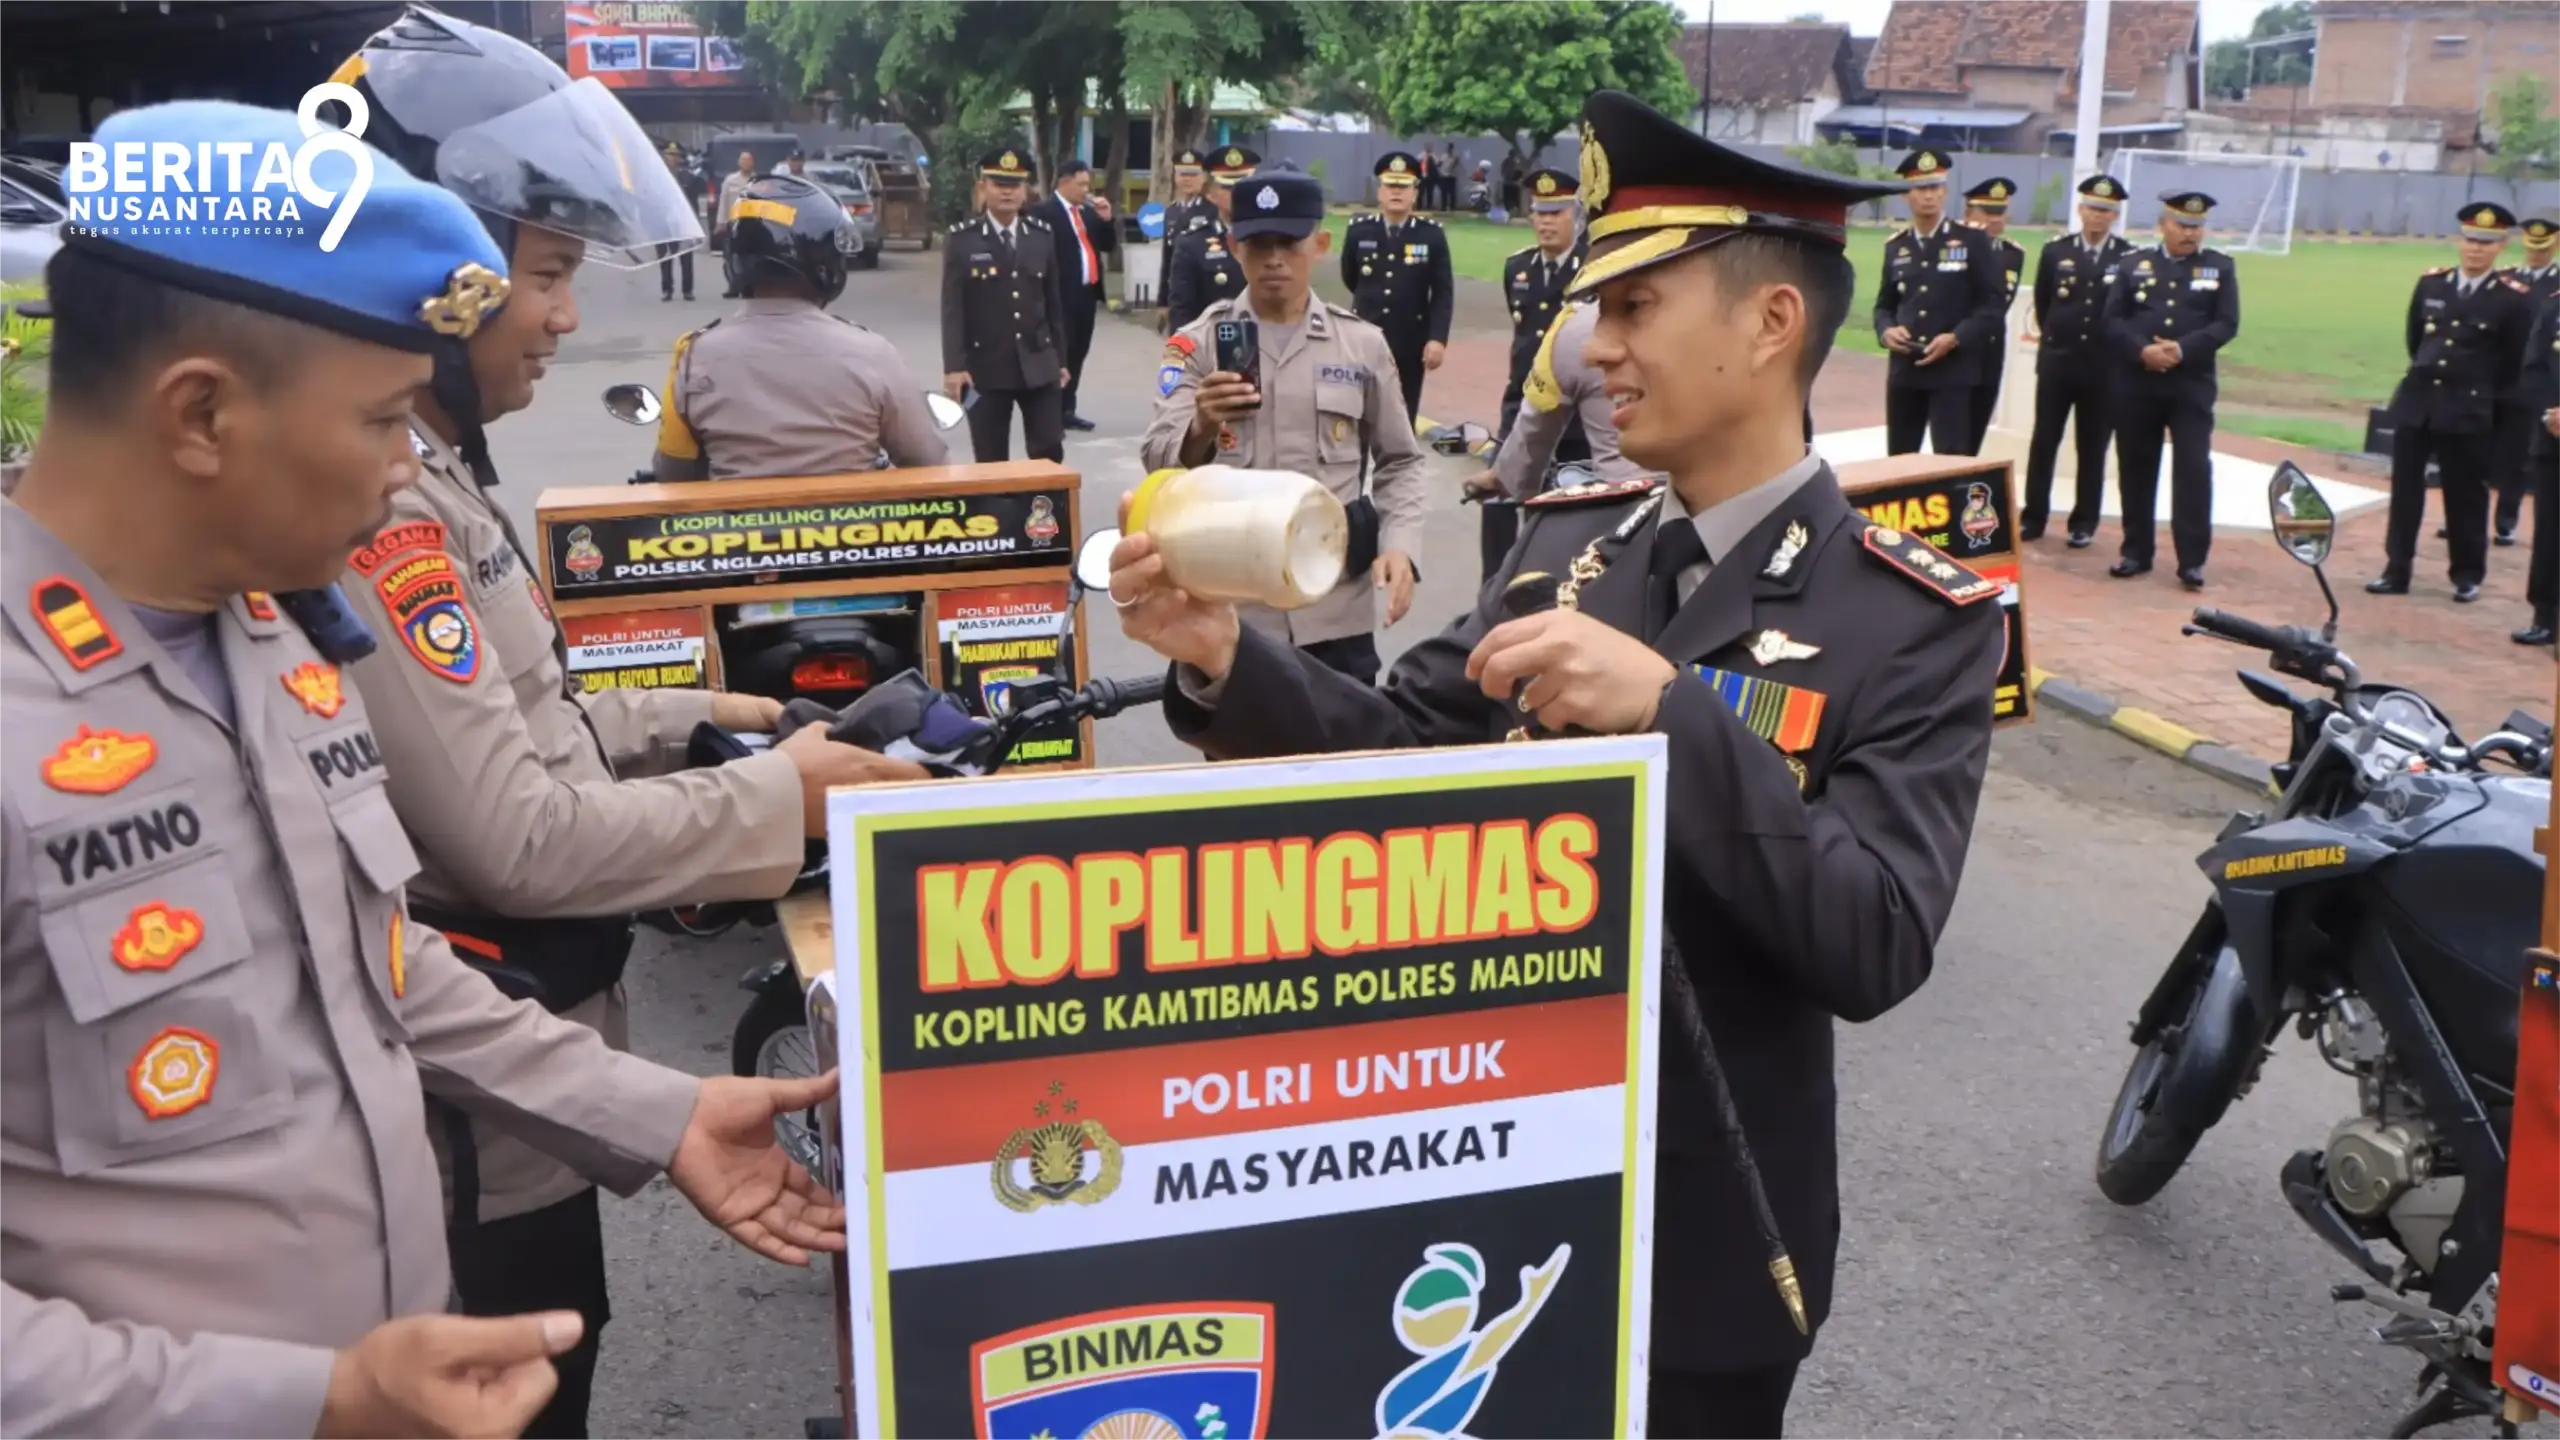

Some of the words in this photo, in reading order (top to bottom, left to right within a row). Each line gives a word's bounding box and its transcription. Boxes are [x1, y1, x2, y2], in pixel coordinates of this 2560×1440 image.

[628, 514, 1000, 562] KOPLINGMAS
[673, 514, 723, 532] KOPI
[730, 508, 824, 528] KELILING
[830, 500, 954, 522] KAMTIBMAS
[358, 526, 442, 567] GEGANA
[614, 559, 706, 579] POLSEK
[713, 551, 824, 570] NGLAMES
[829, 545, 918, 563] POLRES
[924, 537, 1016, 556] MADIUN
[956, 605, 1000, 618] POLRI
[1004, 602, 1053, 615] UNTUK
[957, 615, 1054, 631] MASYARAKAT
[581, 632, 628, 644] POLRI
[631, 627, 683, 641] UNTUK
[581, 641, 684, 658] MASYARAKAT
[46, 802, 201, 886] YATNO
[916, 812, 1599, 993] KOPLINGMAS
[914, 998, 1087, 1049] KOPLING
[1103, 976, 1318, 1032] KAMTIBMAS
[1334, 961, 1457, 1007] POLRES
[1470, 946, 1603, 992] MADIUN
[1163, 1062, 1312, 1119] POLRI
[1335, 1039, 1506, 1098] UNTUK
[1154, 1120, 1516, 1205] MASYARAKAT
[1023, 1317, 1225, 1383] BINMAS
